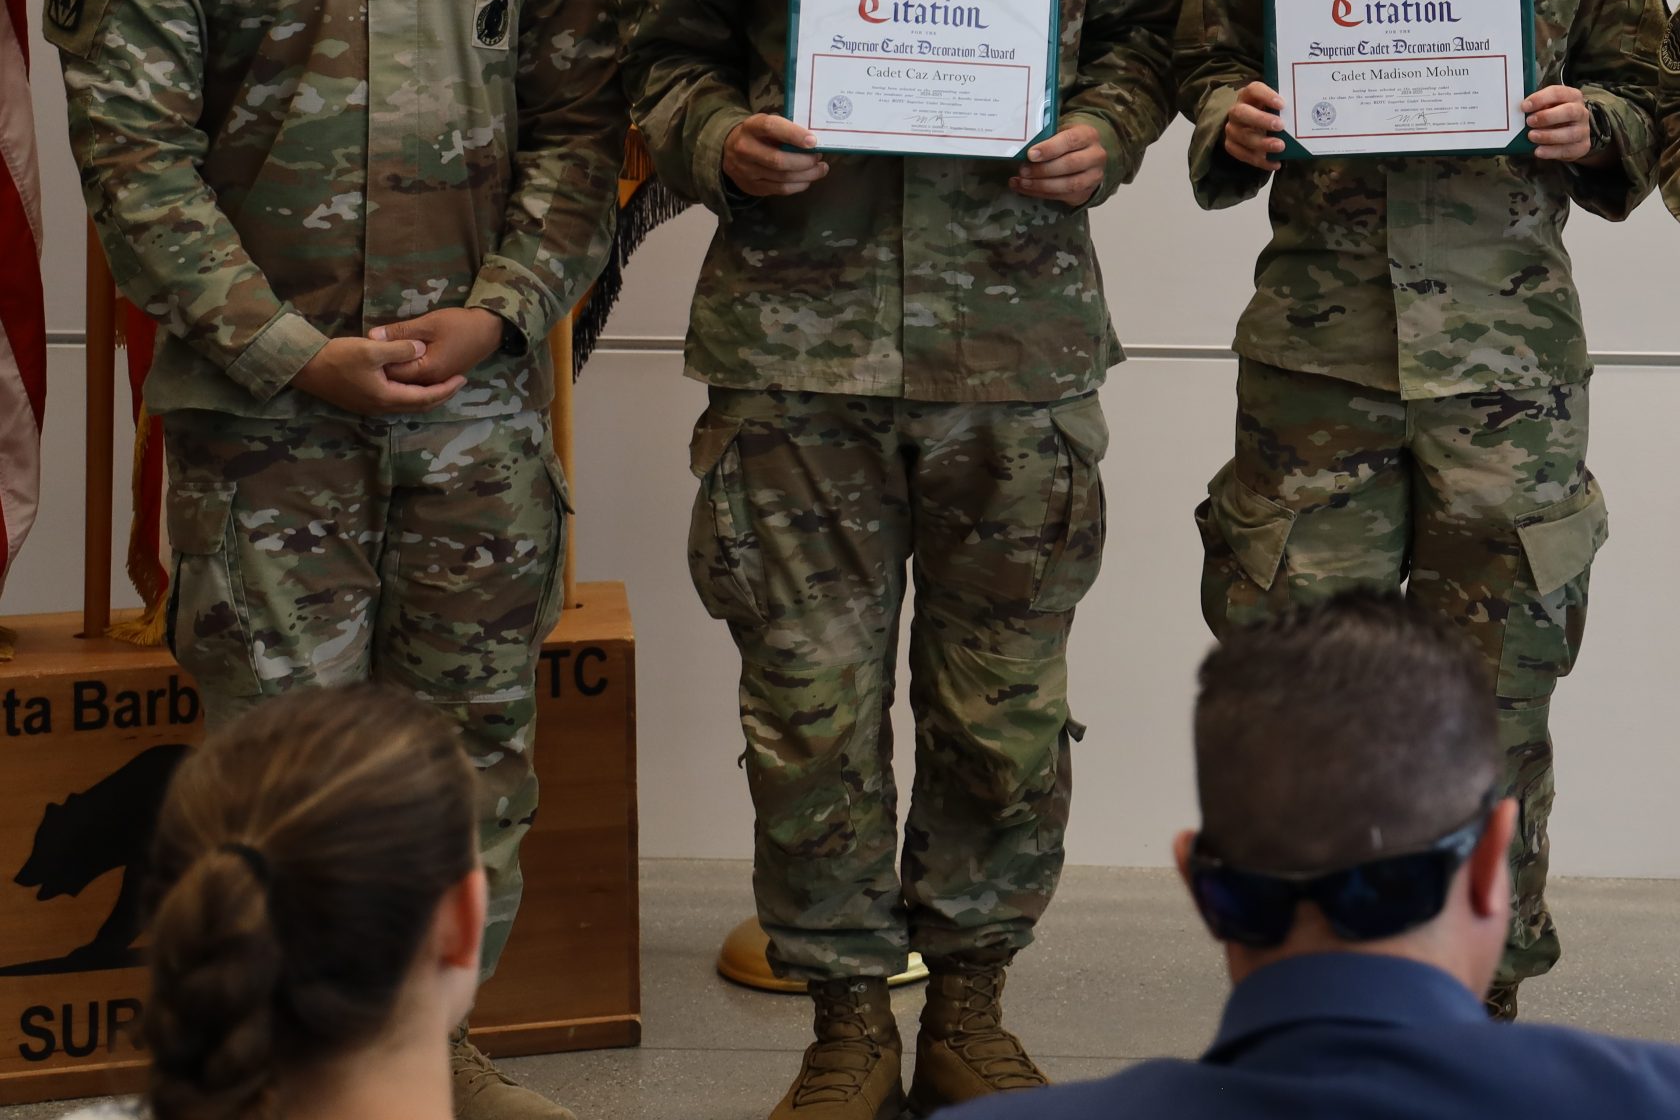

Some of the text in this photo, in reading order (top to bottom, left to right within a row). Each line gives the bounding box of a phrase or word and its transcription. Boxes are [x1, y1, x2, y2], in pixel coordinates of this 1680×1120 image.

[830, 34, 1015, 60] Superior Cadet Decoration Award
[1308, 36, 1490, 60] Superior Cadet Decoration Award
[866, 65, 976, 86] Cadet Caz Arroyo
[1330, 65, 1470, 82] Cadet Madison Mohun
